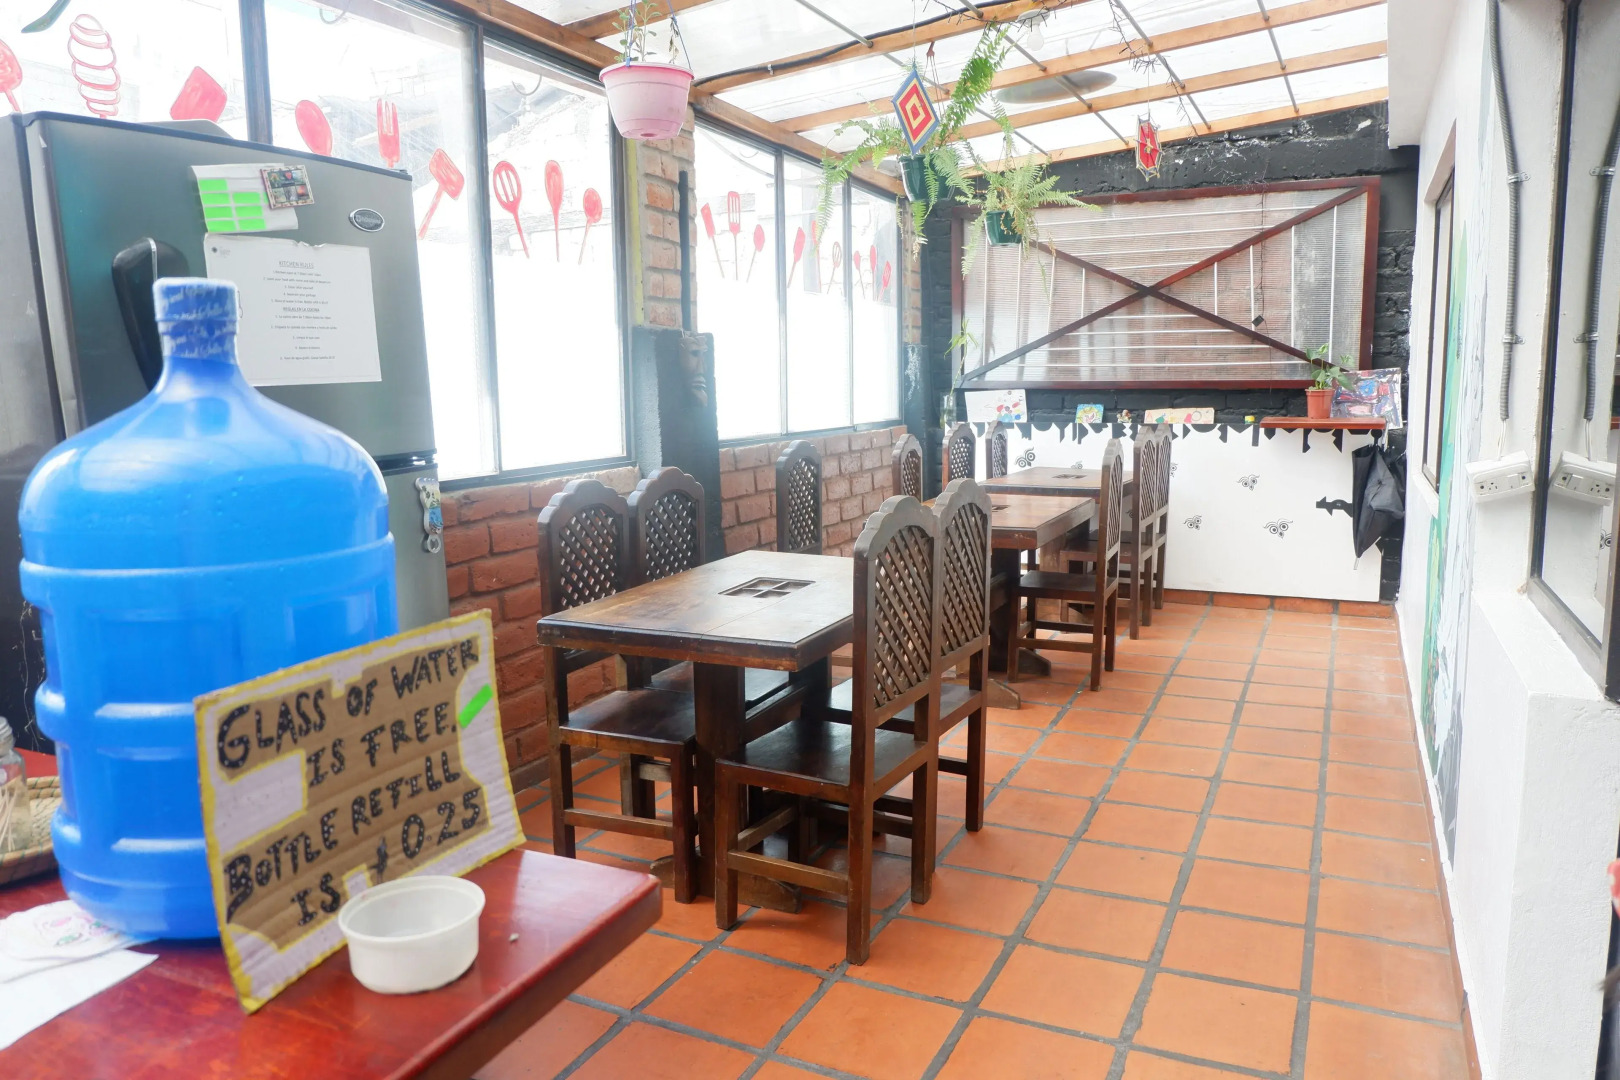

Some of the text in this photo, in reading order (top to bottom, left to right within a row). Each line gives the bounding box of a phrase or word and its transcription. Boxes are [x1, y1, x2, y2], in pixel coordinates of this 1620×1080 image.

[217, 639, 479, 769] GLASS OF WATER
[306, 702, 457, 788] IS FREE.
[224, 751, 461, 924] BOTTLE REFILL
[291, 872, 340, 926] IS
